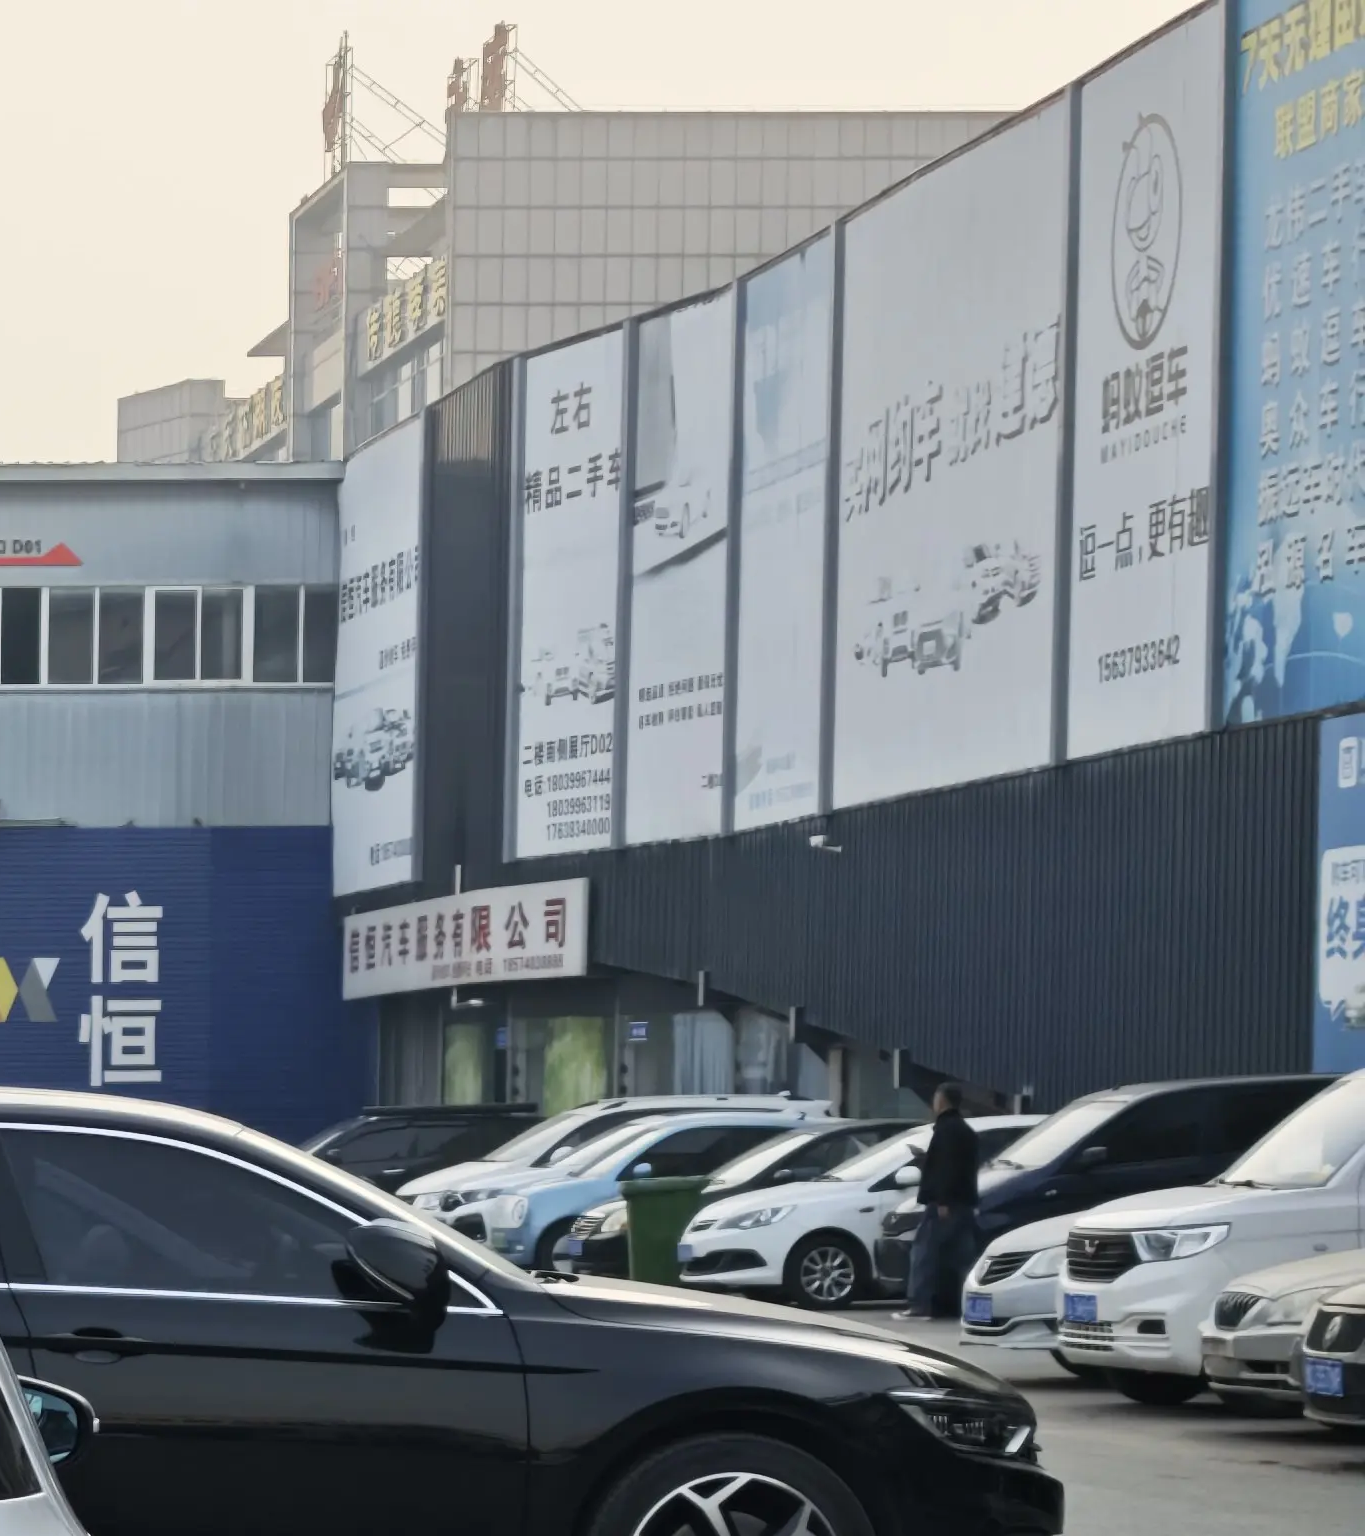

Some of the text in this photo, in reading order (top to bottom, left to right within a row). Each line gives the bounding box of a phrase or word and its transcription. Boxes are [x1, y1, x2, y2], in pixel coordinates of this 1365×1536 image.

[1240, 0, 1365, 95] 7天无理由
[550, 381, 592, 435] 左右
[1100, 345, 1188, 434] 蚂蚁逗车
[525, 447, 621, 514] 精品二手车
[348, 897, 566, 974] 信恒汽车服务有限公司
[78, 890, 163, 1087] 信恒
